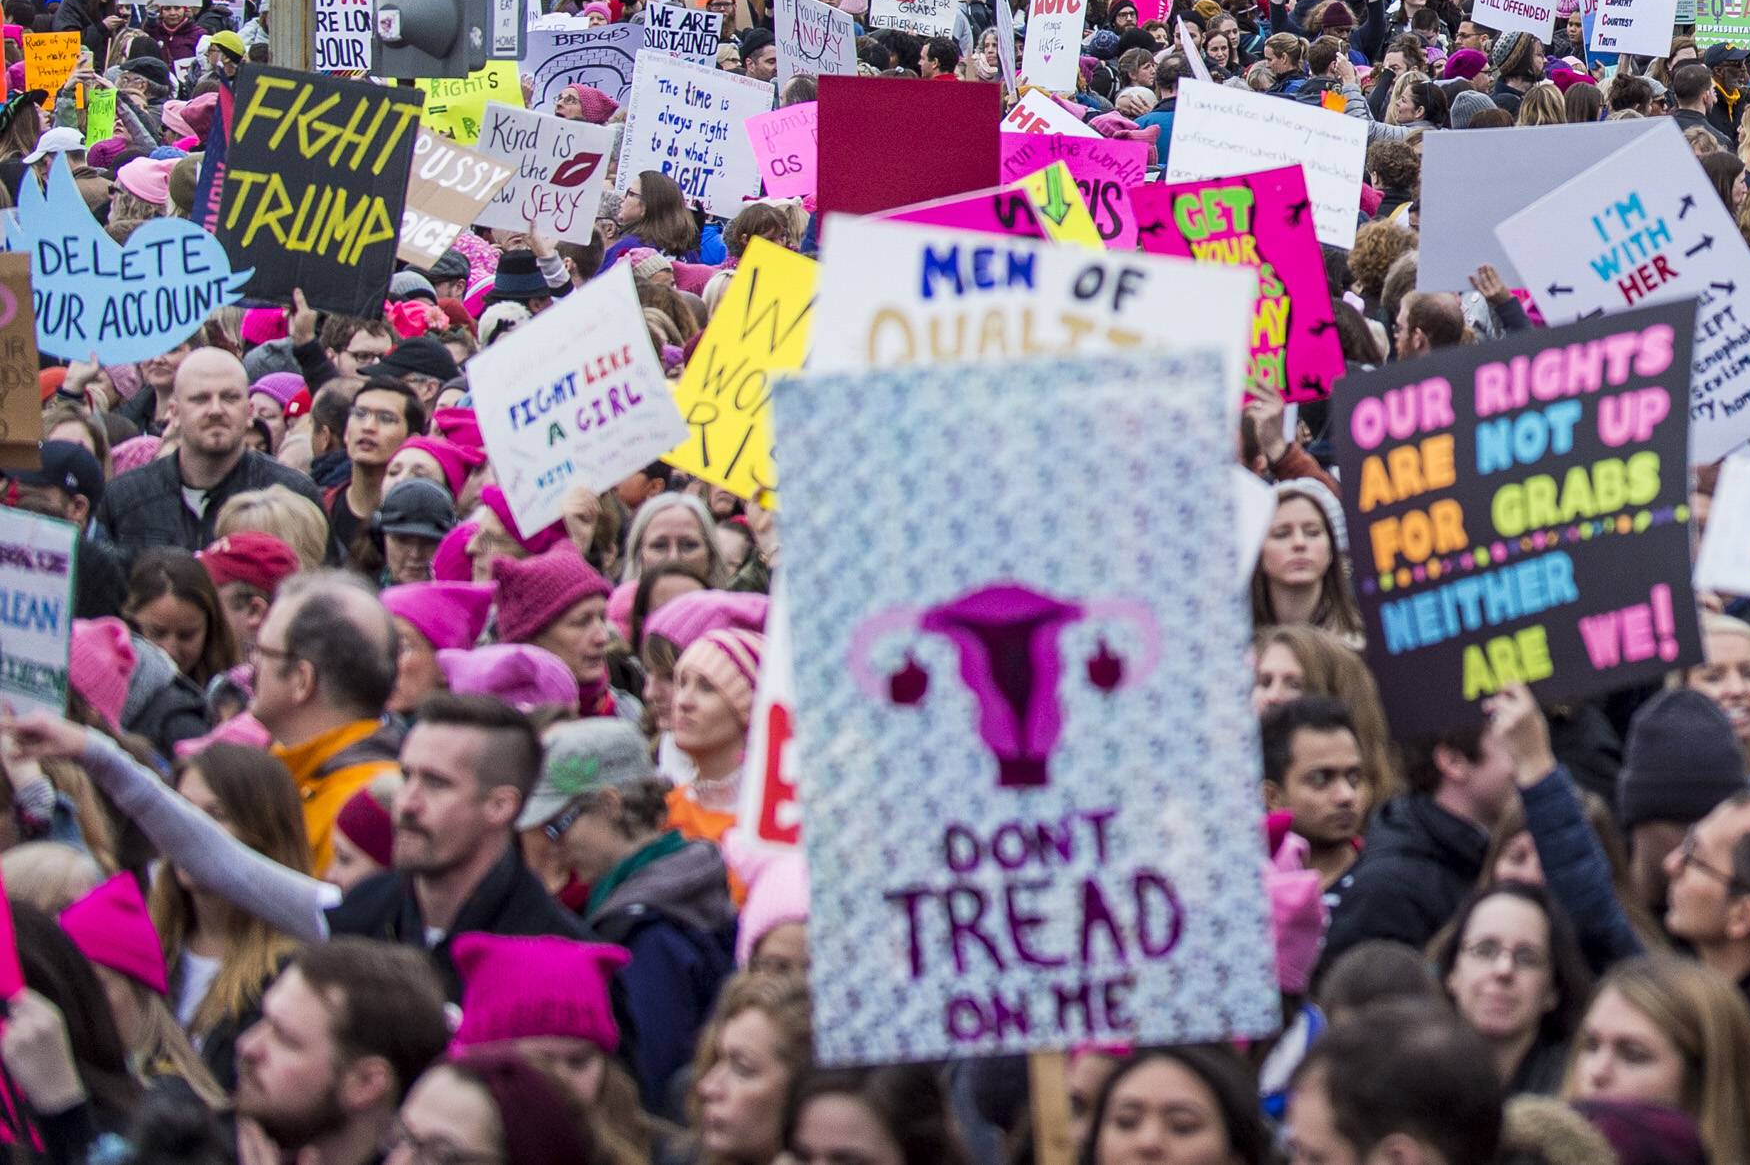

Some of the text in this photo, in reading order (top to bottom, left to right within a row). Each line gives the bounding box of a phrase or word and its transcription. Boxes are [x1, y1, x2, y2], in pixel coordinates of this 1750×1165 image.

[500, 0, 514, 11] EAT
[503, 18, 512, 28] AT
[648, 5, 718, 35] WE ARE
[799, 0, 830, 26] YOU'RE
[831, 17, 851, 38] NOT
[869, 15, 952, 39] NEITHER ARE WE
[898, 2, 938, 17] GRABS
[1502, 0, 1551, 23] OFFENDED!
[1601, 14, 1633, 28] COURTESY
[495, 35, 517, 47] HOME
[551, 26, 632, 48] BRIDGES
[643, 28, 720, 57] SUSTAINED
[791, 20, 843, 61] ANGRY
[1598, 33, 1617, 47] TRUTH
[818, 55, 842, 75] NOT
[684, 80, 712, 110] time
[720, 97, 730, 112] is
[234, 74, 423, 176] FIGHT
[489, 112, 575, 158] Kind is
[657, 104, 729, 144] always right
[520, 154, 548, 181] the
[651, 132, 724, 168] to do what is
[771, 154, 803, 178] as
[1003, 136, 1146, 189] run the world?
[226, 170, 396, 267] TRUMP
[521, 184, 585, 233] SEXY
[1173, 185, 1254, 241] GET
[1592, 191, 1647, 244] I'M
[38, 234, 211, 281] DELETE
[1189, 236, 1261, 265] YOUR
[1590, 217, 1673, 282] WITH
[919, 244, 1147, 314] MEN OF
[1617, 254, 1680, 306] HER
[98, 276, 229, 341] ACCOUNT
[508, 344, 634, 431] FIGHT LIKE
[1350, 323, 1676, 450] OUR RIGHTS
[549, 380, 644, 447] A GIRL
[1358, 386, 1671, 513] ARE NOT UP
[1368, 451, 1662, 574] FOR GRABS
[1380, 550, 1580, 655] NEITHER
[1461, 582, 1680, 702] ARE WE!
[882, 865, 1186, 980] TREAD
[946, 975, 1137, 1042] ON ME
